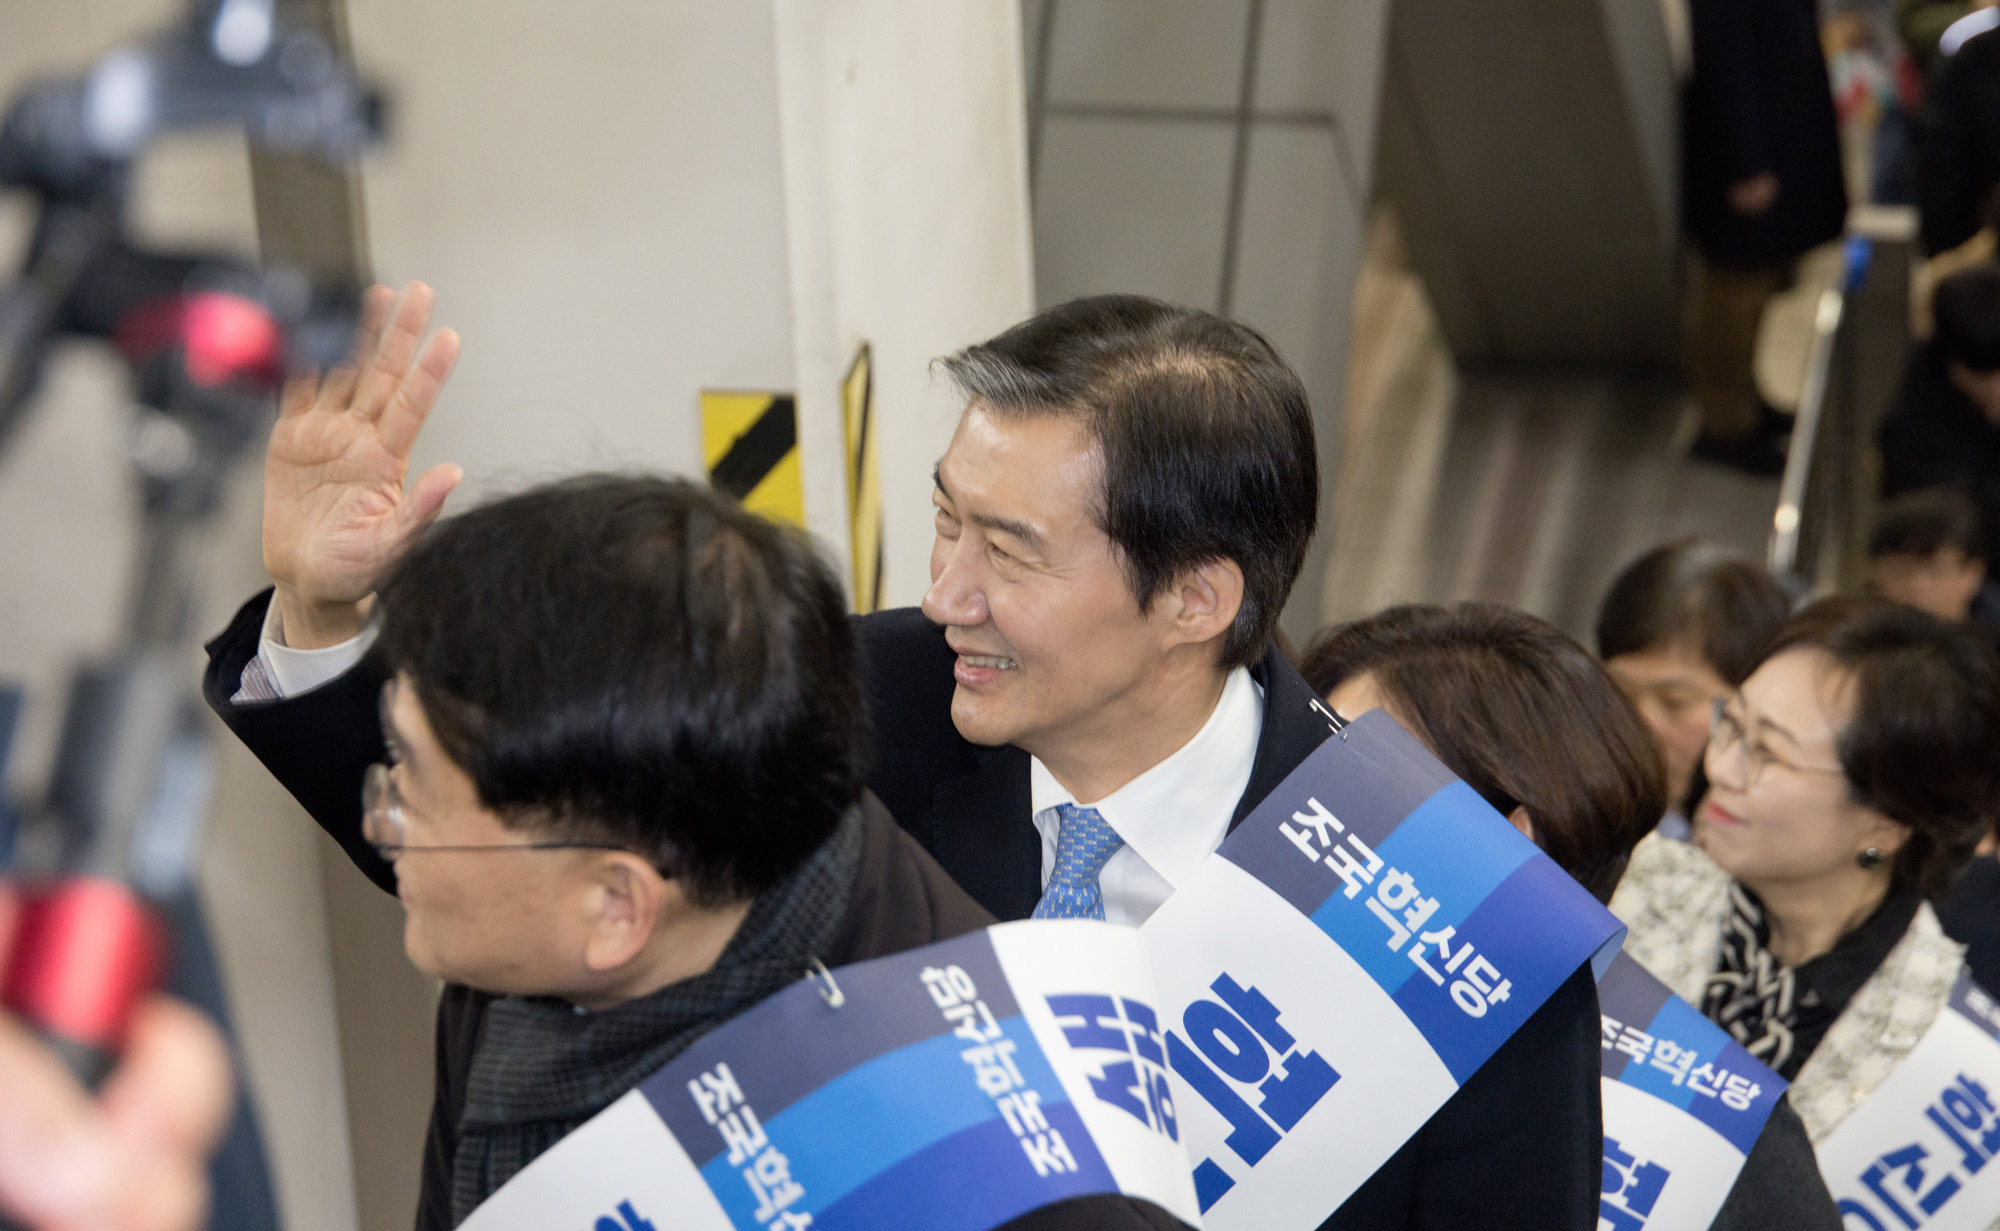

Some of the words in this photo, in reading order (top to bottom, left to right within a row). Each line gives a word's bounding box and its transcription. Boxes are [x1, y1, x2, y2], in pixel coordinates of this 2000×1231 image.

[1279, 797, 1512, 1018] 조국혁신당
[919, 965, 1078, 1177] 조국혁신당
[1163, 971, 1342, 1217] 혁
